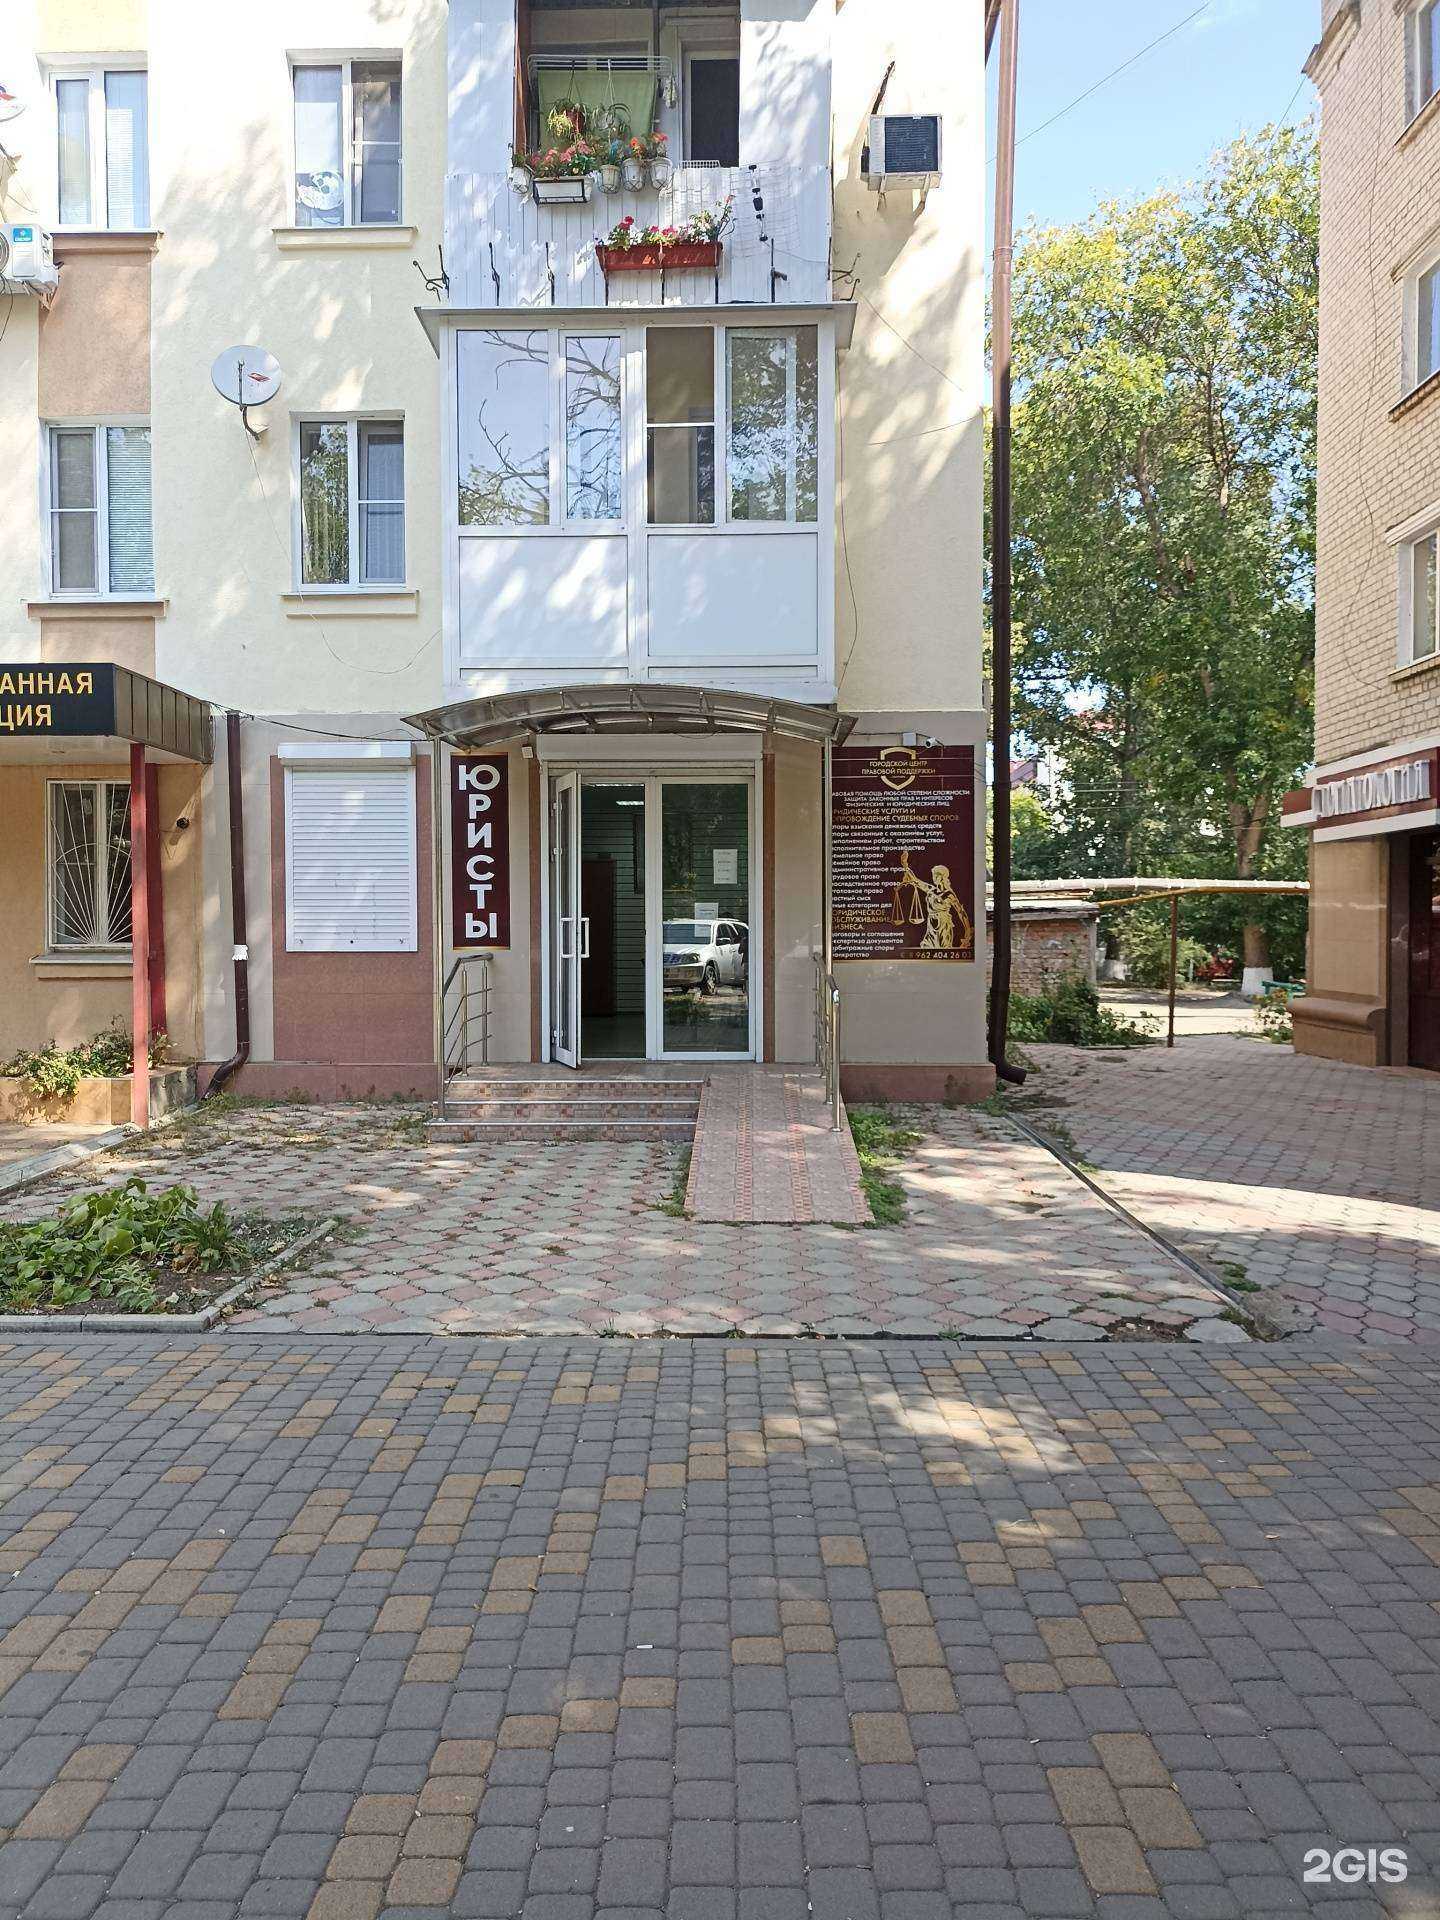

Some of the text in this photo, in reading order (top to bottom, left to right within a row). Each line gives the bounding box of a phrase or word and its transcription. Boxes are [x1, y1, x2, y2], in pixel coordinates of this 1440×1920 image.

[869, 760, 928, 768] ГОРОДСКОЙ ЦЕНТР
[861, 767, 896, 775] ПРАВОВОЙ
[458, 764, 501, 939] ЮРИСТЫ
[915, 950, 931, 959] 962
[932, 950, 948, 959] 404
[949, 950, 960, 959] 26
